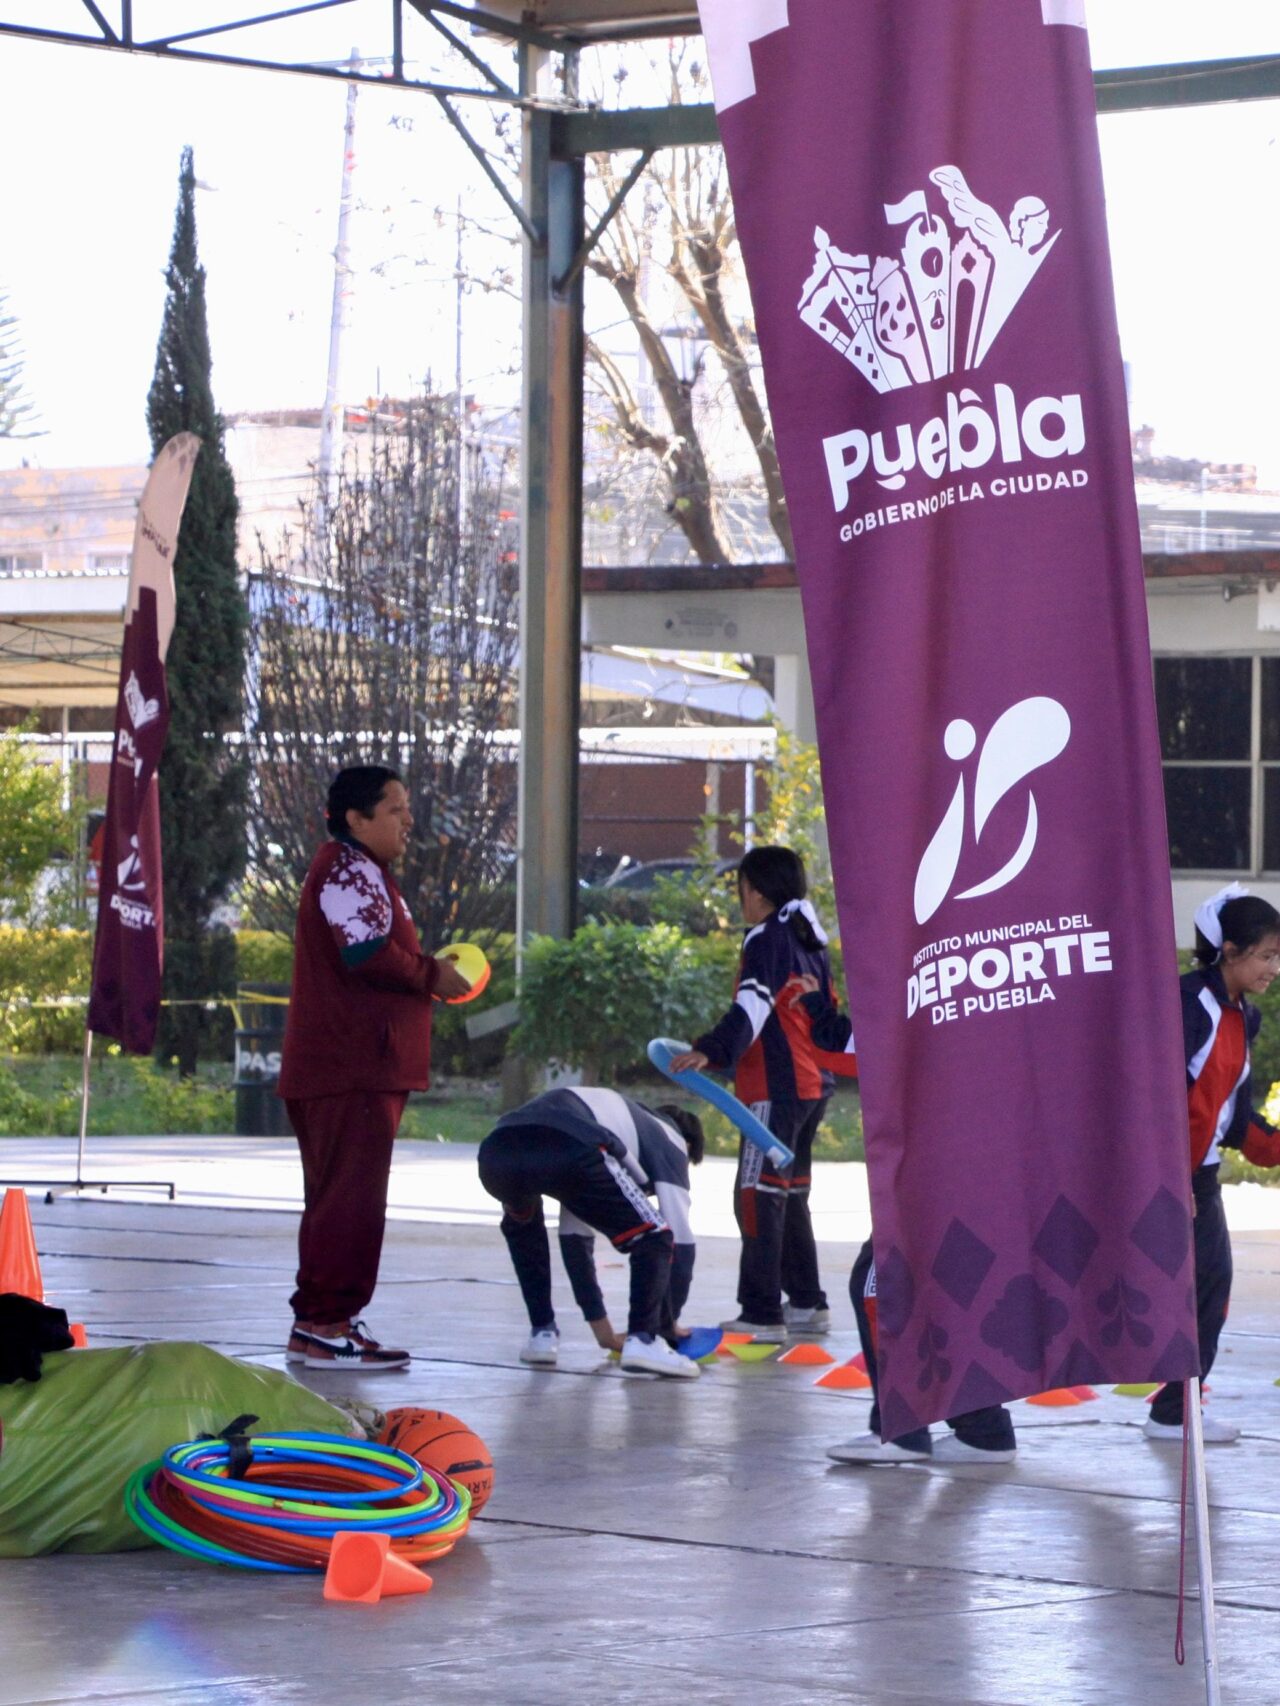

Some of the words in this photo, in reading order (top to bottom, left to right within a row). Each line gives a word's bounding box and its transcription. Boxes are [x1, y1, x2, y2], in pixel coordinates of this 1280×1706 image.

[840, 495, 938, 542] GOBIERNO
[939, 488, 955, 509] DE
[959, 482, 984, 502] LA
[990, 469, 1089, 497] CIUDAD
[913, 936, 962, 969] INSTITUTO
[965, 919, 1055, 947] MUNICIPAL
[1059, 914, 1092, 931] DEL
[907, 931, 1113, 1019] DEPORTE
[932, 1001, 958, 1025] DE
[963, 983, 1056, 1017] PUEBLA
